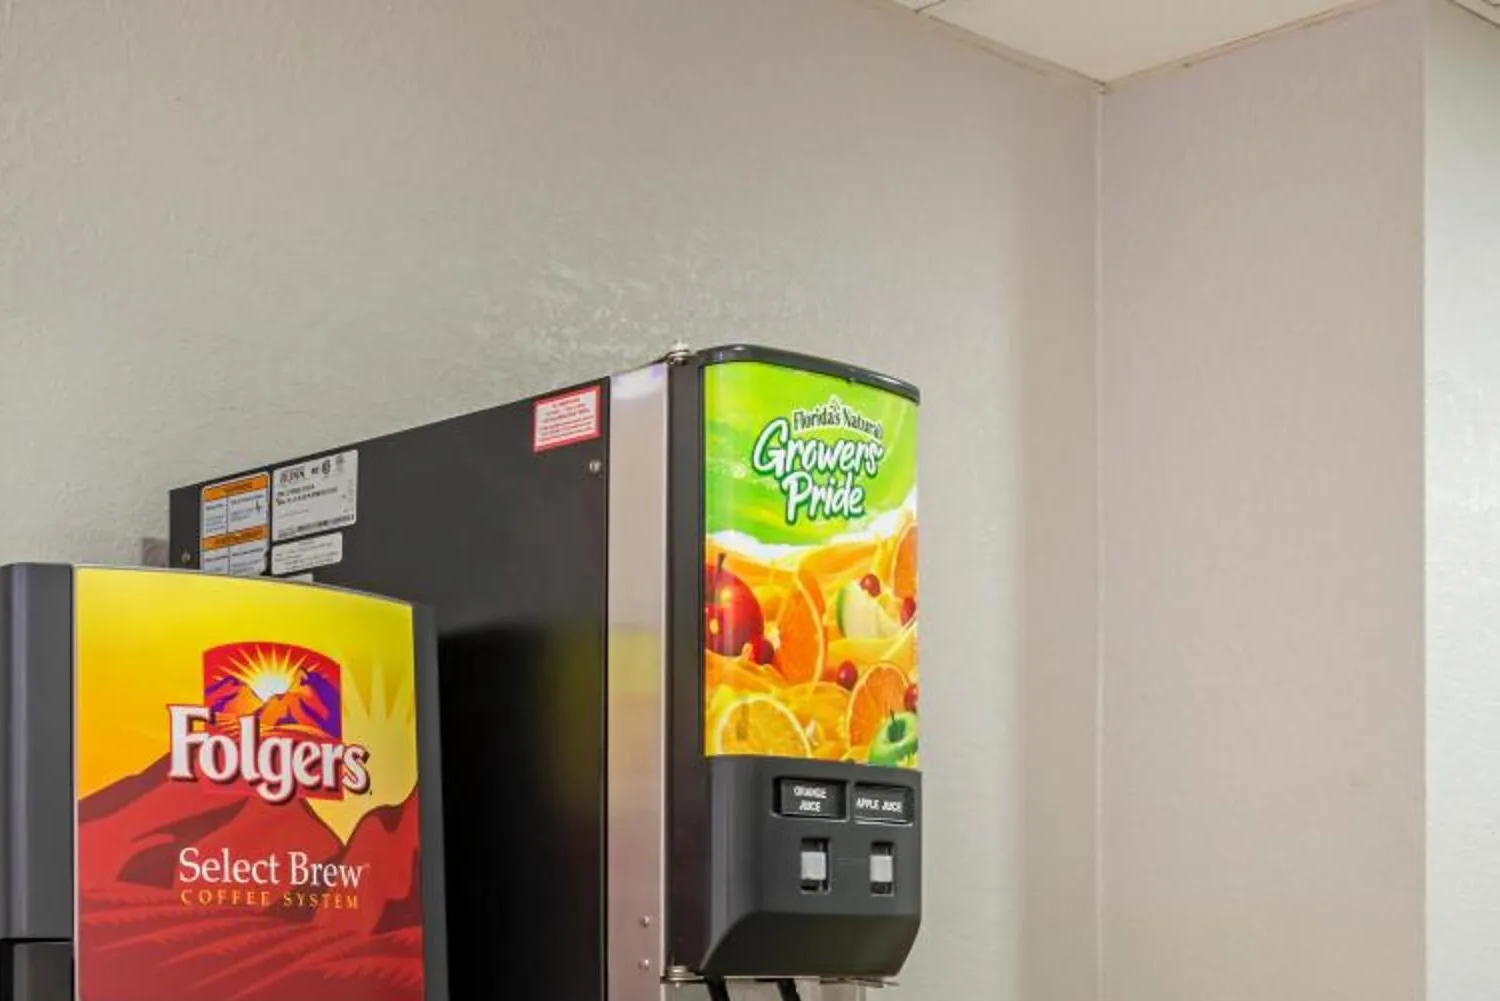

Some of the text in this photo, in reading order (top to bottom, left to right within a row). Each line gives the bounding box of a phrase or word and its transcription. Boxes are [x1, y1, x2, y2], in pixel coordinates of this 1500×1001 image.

[793, 405, 840, 432] Florida's
[780, 470, 866, 526] Pride
[167, 703, 371, 804] Folgers
[793, 785, 828, 799] ORANGE
[799, 799, 821, 813] JUICE
[855, 797, 903, 813] APPLE JUICE
[179, 846, 363, 890] Select Brew
[180, 888, 359, 910] COFFEE SYSTEM
